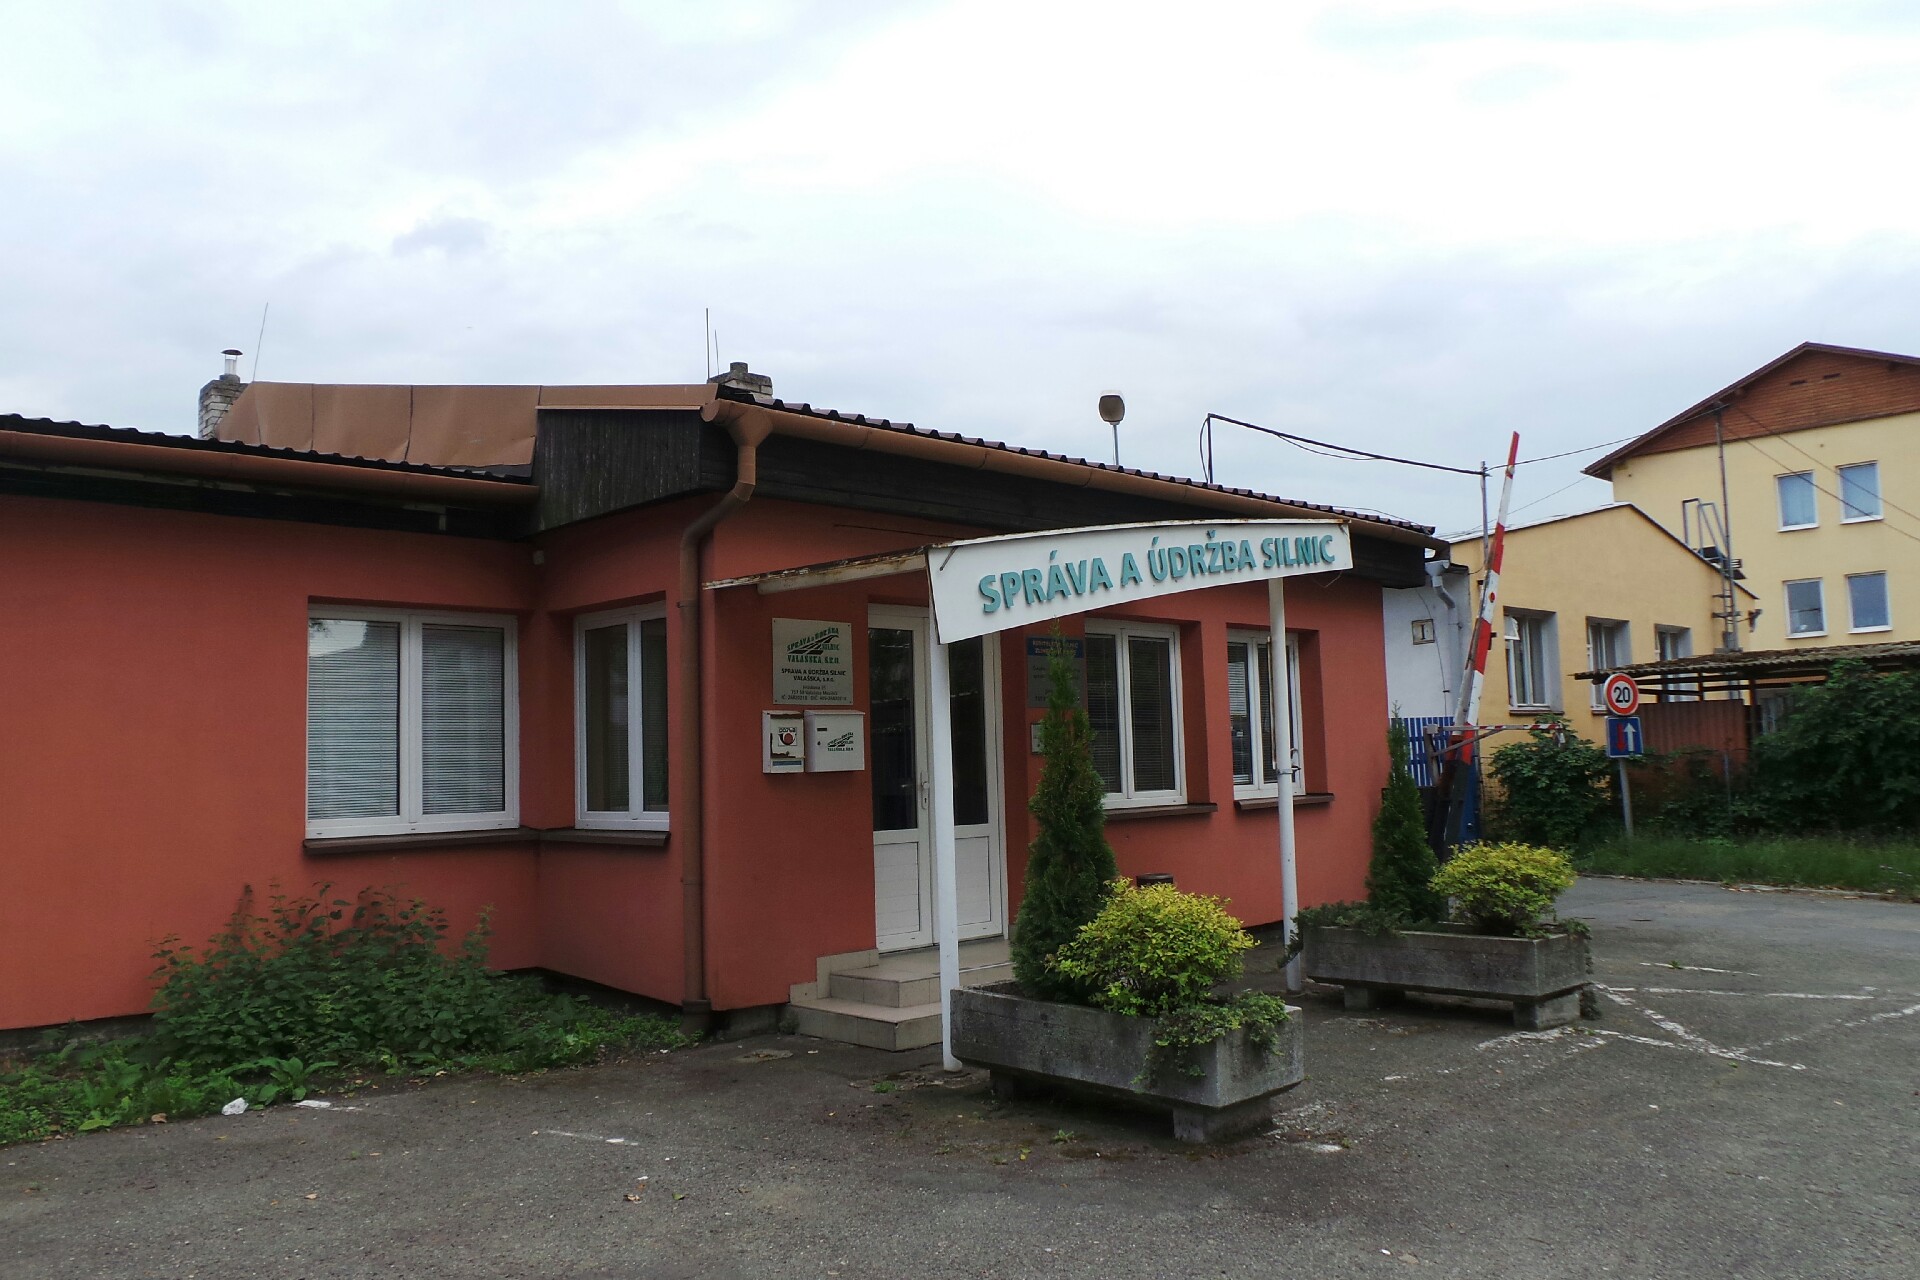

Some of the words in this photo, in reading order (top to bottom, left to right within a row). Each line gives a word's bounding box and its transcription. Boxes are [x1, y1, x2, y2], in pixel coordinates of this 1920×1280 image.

[979, 550, 1113, 613] SPRÁVA
[1121, 553, 1143, 587] A
[1148, 530, 1257, 582] ÚDRŽBA
[1261, 534, 1336, 569] SILNIC
[1613, 686, 1631, 704] 20
